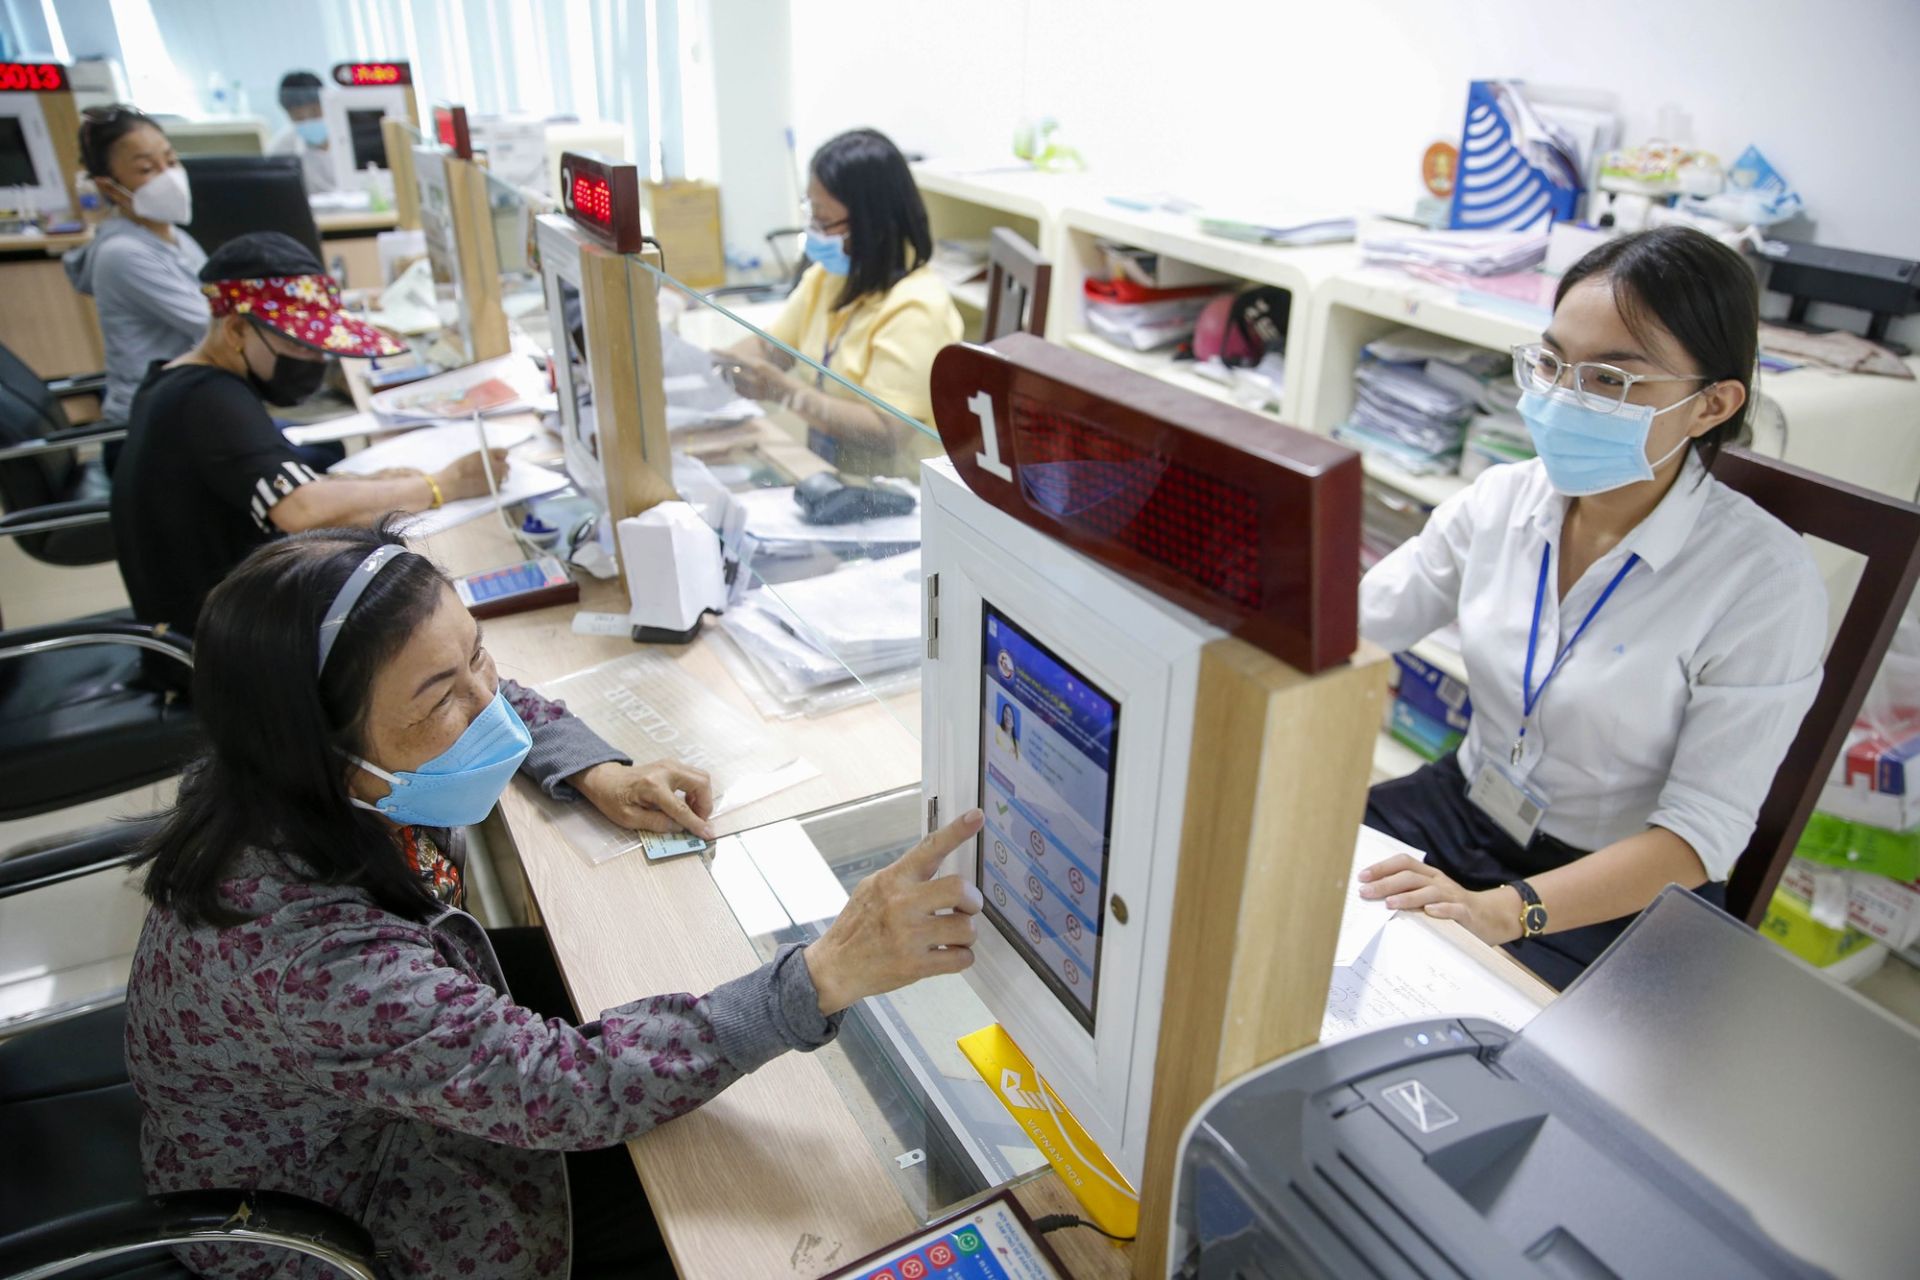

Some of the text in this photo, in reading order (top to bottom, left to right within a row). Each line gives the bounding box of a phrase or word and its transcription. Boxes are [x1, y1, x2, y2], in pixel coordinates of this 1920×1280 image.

[562, 167, 574, 210] 2
[967, 390, 1013, 483] 1
[1027, 1118, 1064, 1163] VIETNAM
